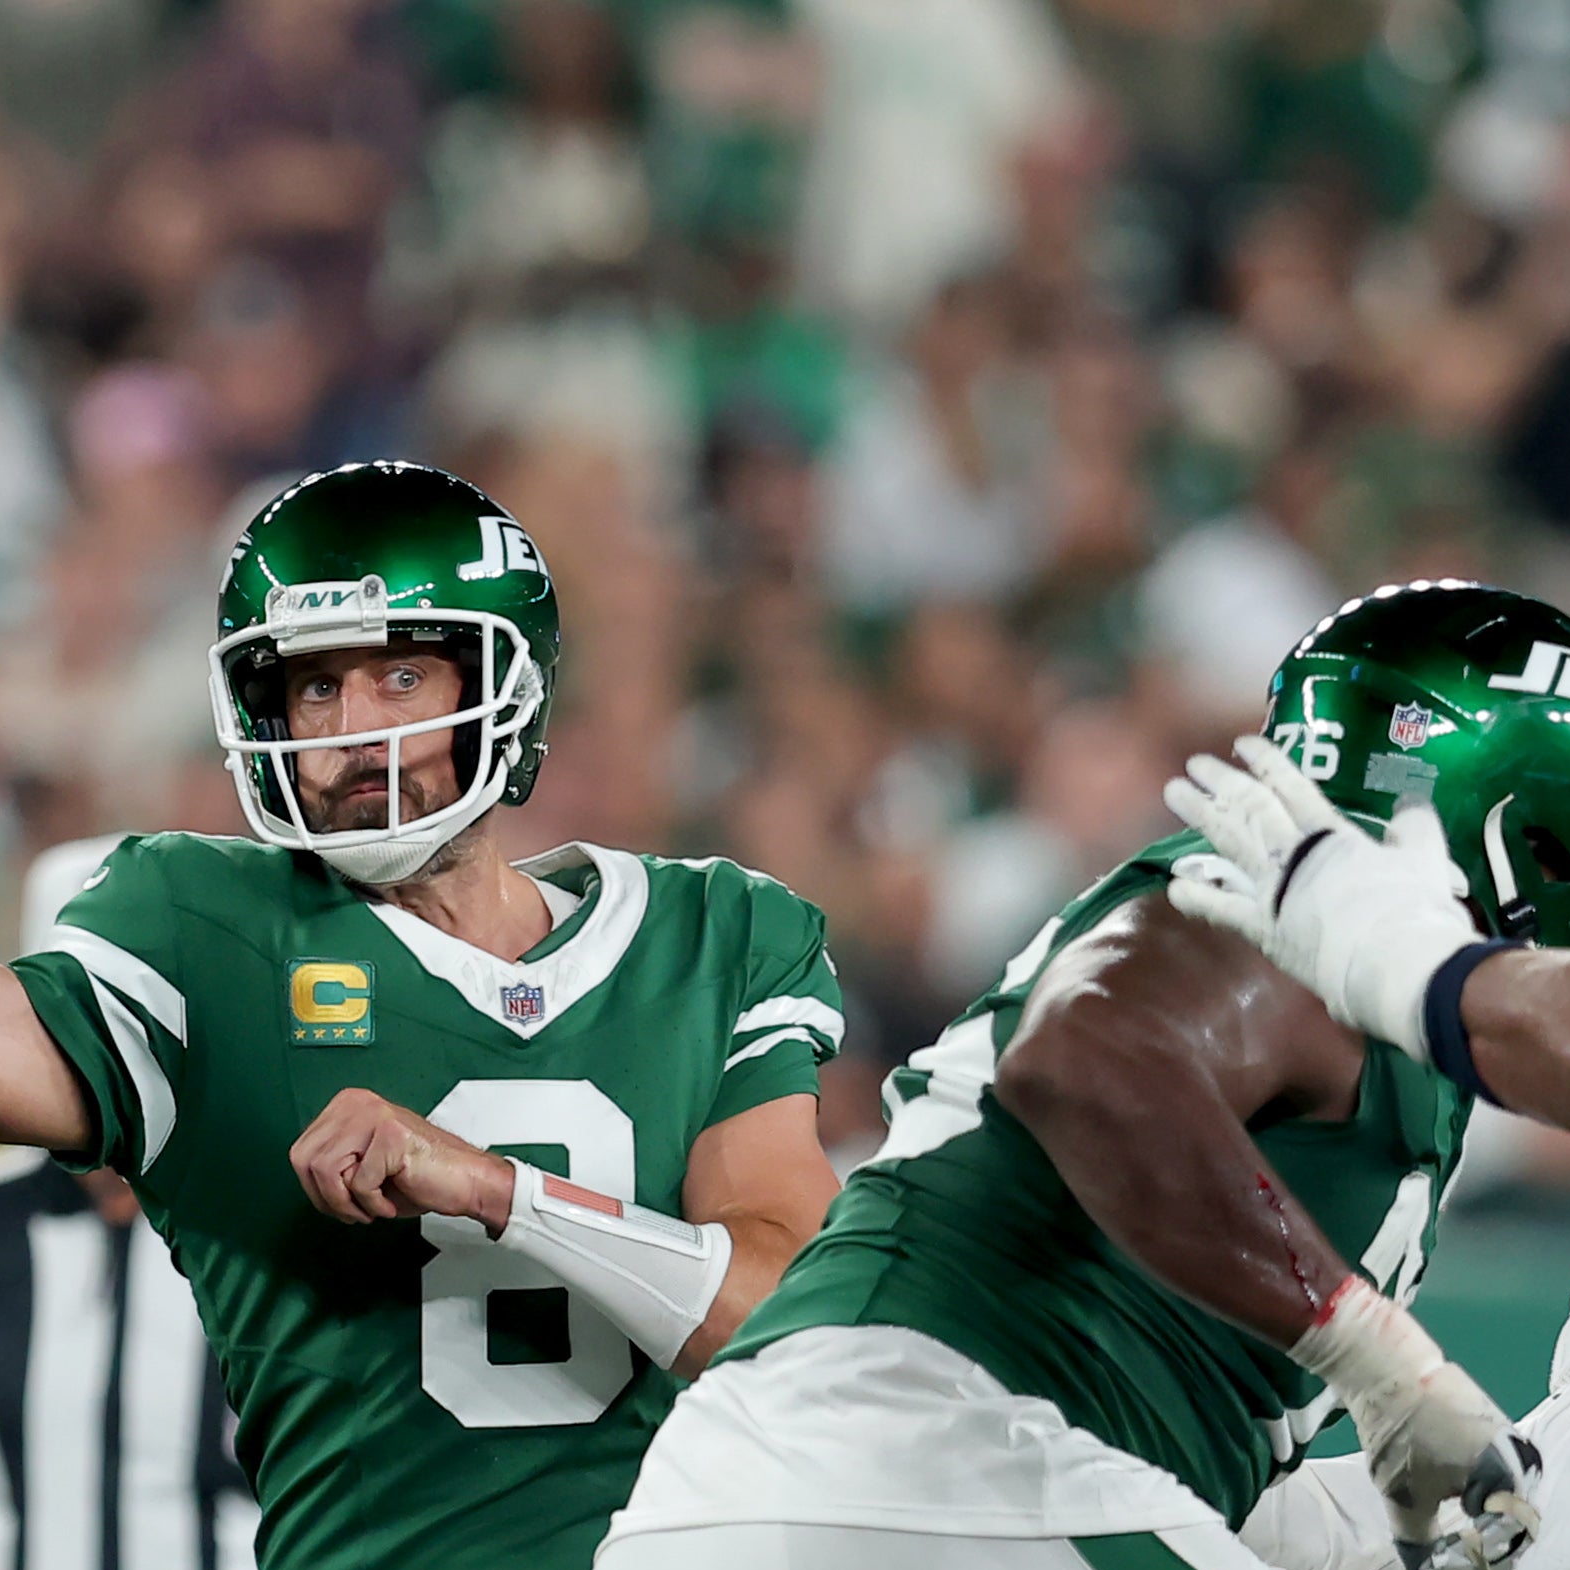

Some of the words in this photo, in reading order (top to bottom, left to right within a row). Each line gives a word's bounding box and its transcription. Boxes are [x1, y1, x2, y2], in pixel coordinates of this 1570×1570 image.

[1273, 718, 1345, 781] 76
[291, 962, 369, 1024] C
[420, 1079, 636, 1428] 8
